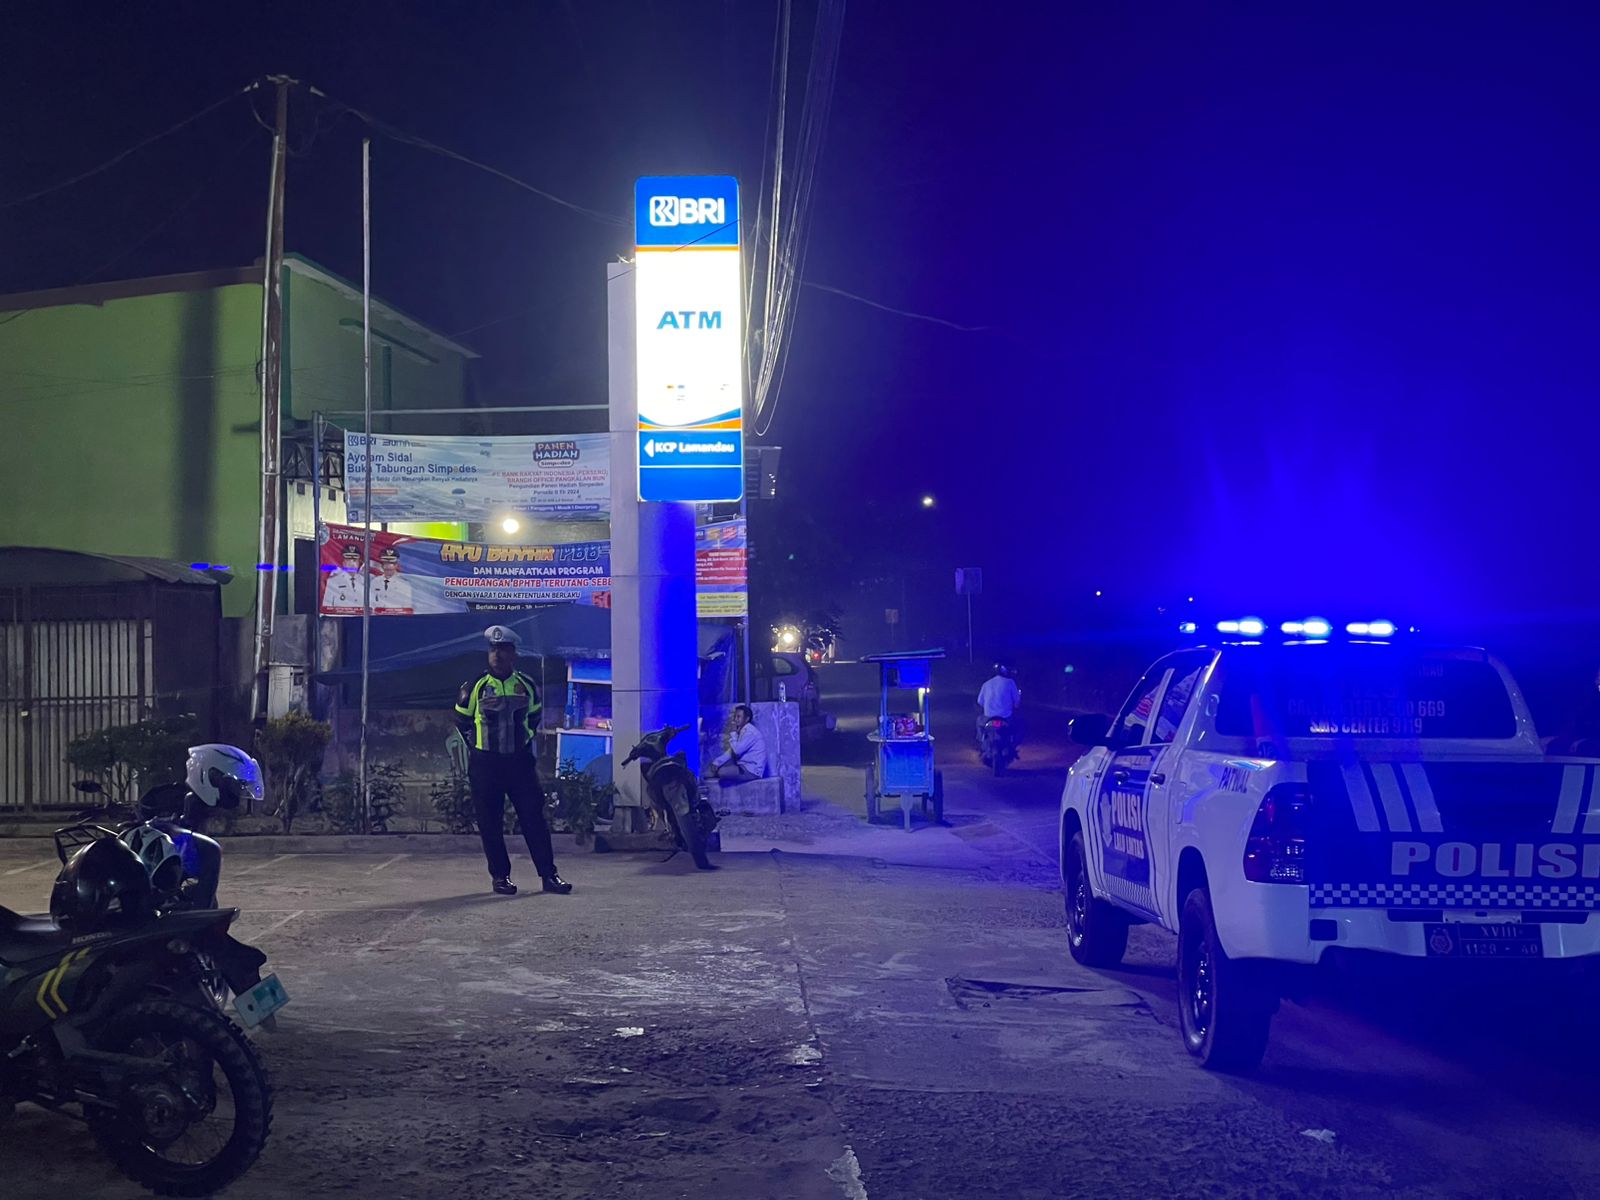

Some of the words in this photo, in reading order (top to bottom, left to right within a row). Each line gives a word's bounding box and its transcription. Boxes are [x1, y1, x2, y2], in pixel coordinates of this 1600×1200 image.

[679, 197, 725, 224] BRI
[656, 311, 722, 329] ATM
[538, 442, 574, 450] PANEN
[655, 442, 678, 453] KCP
[679, 441, 735, 453] Lamandau
[536, 450, 578, 459] HADIAH
[375, 463, 425, 475] Tabungan
[428, 463, 477, 475] Simpedes
[473, 567, 492, 575] DAN
[494, 567, 557, 576] MANFAATKAN
[558, 566, 604, 575] PROGRAM
[445, 578, 510, 587] PENGURANGAN
[512, 578, 541, 588] BPHTB
[544, 578, 589, 588] TERUTANG
[1417, 700, 1446, 717] 669
[1309, 716, 1339, 734] SMS
[1341, 717, 1389, 734] CENTER
[1111, 790, 1142, 832] POLISI
[1391, 841, 1600, 878] POLISI
[1481, 926, 1517, 938] XVIII
